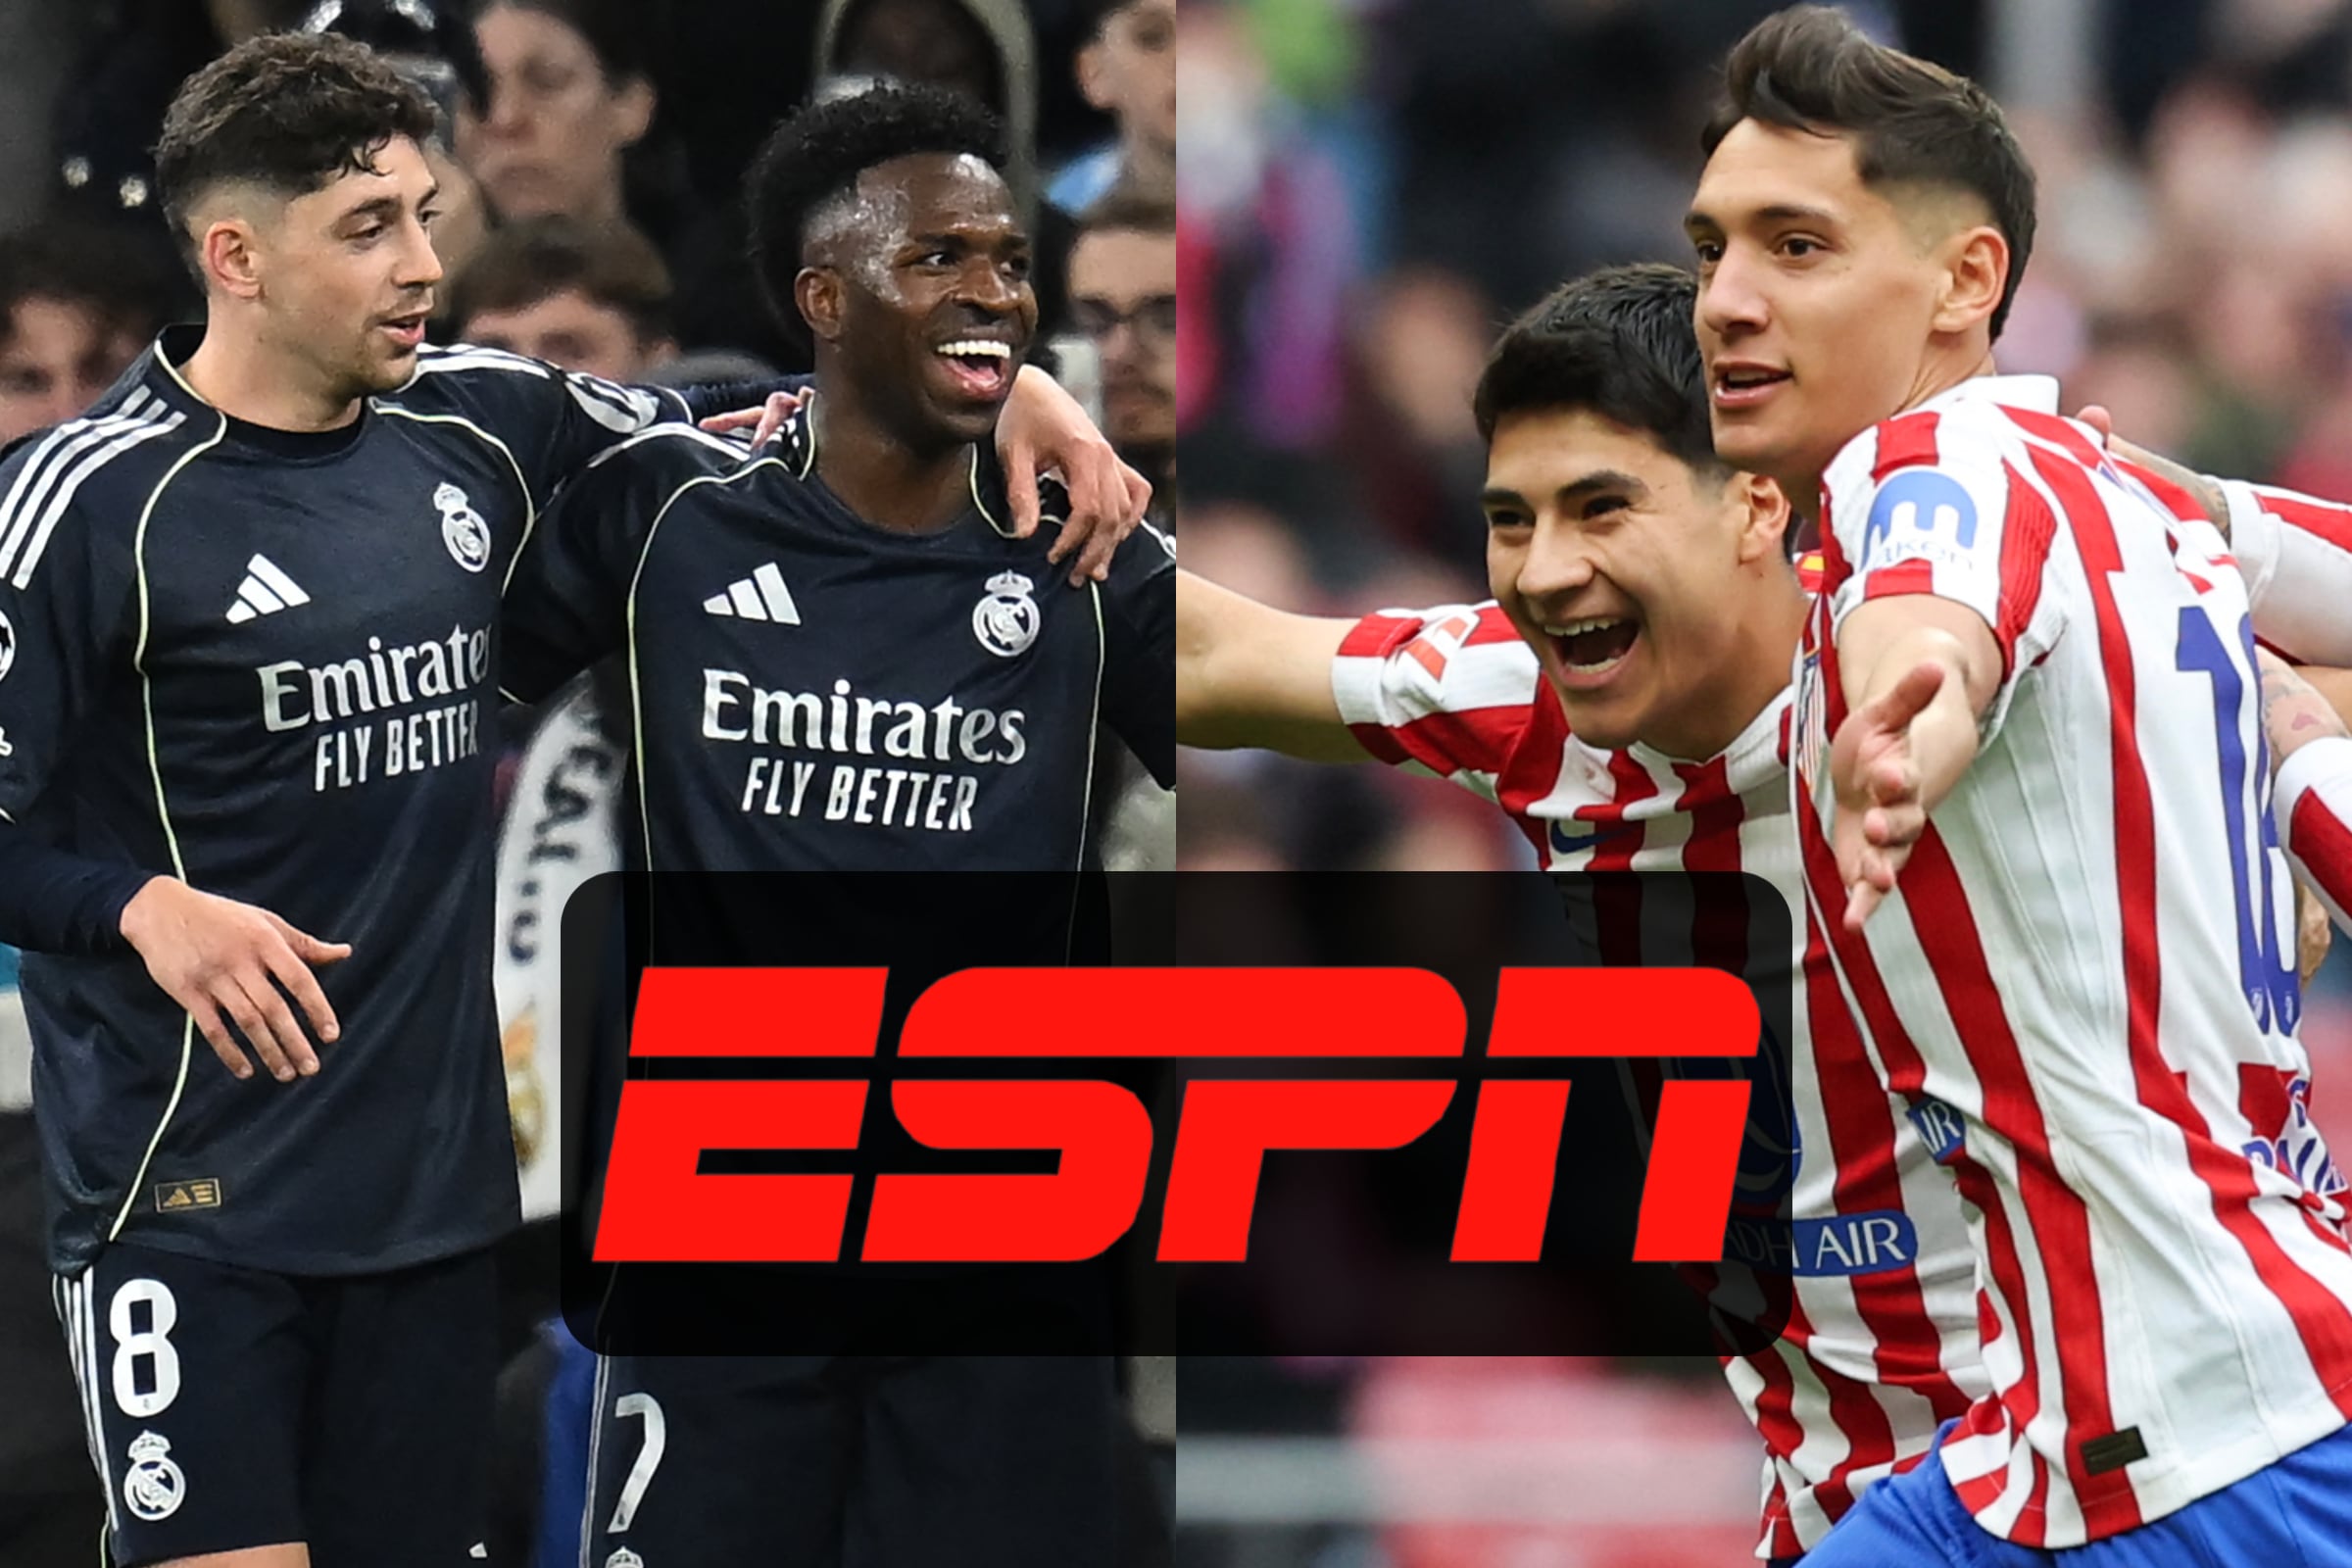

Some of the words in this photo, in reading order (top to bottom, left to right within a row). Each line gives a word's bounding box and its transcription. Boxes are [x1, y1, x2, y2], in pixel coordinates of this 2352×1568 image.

[256, 623, 491, 733] Emirate
[702, 668, 1026, 764] Emirates
[315, 725, 371, 792] FLY
[385, 700, 479, 777] BETTER
[741, 757, 815, 817] FLY
[824, 764, 978, 832] BETTER
[1816, 1218, 1906, 1269] AIR
[110, 1279, 180, 1417] 8
[607, 1393, 665, 1533] 7
